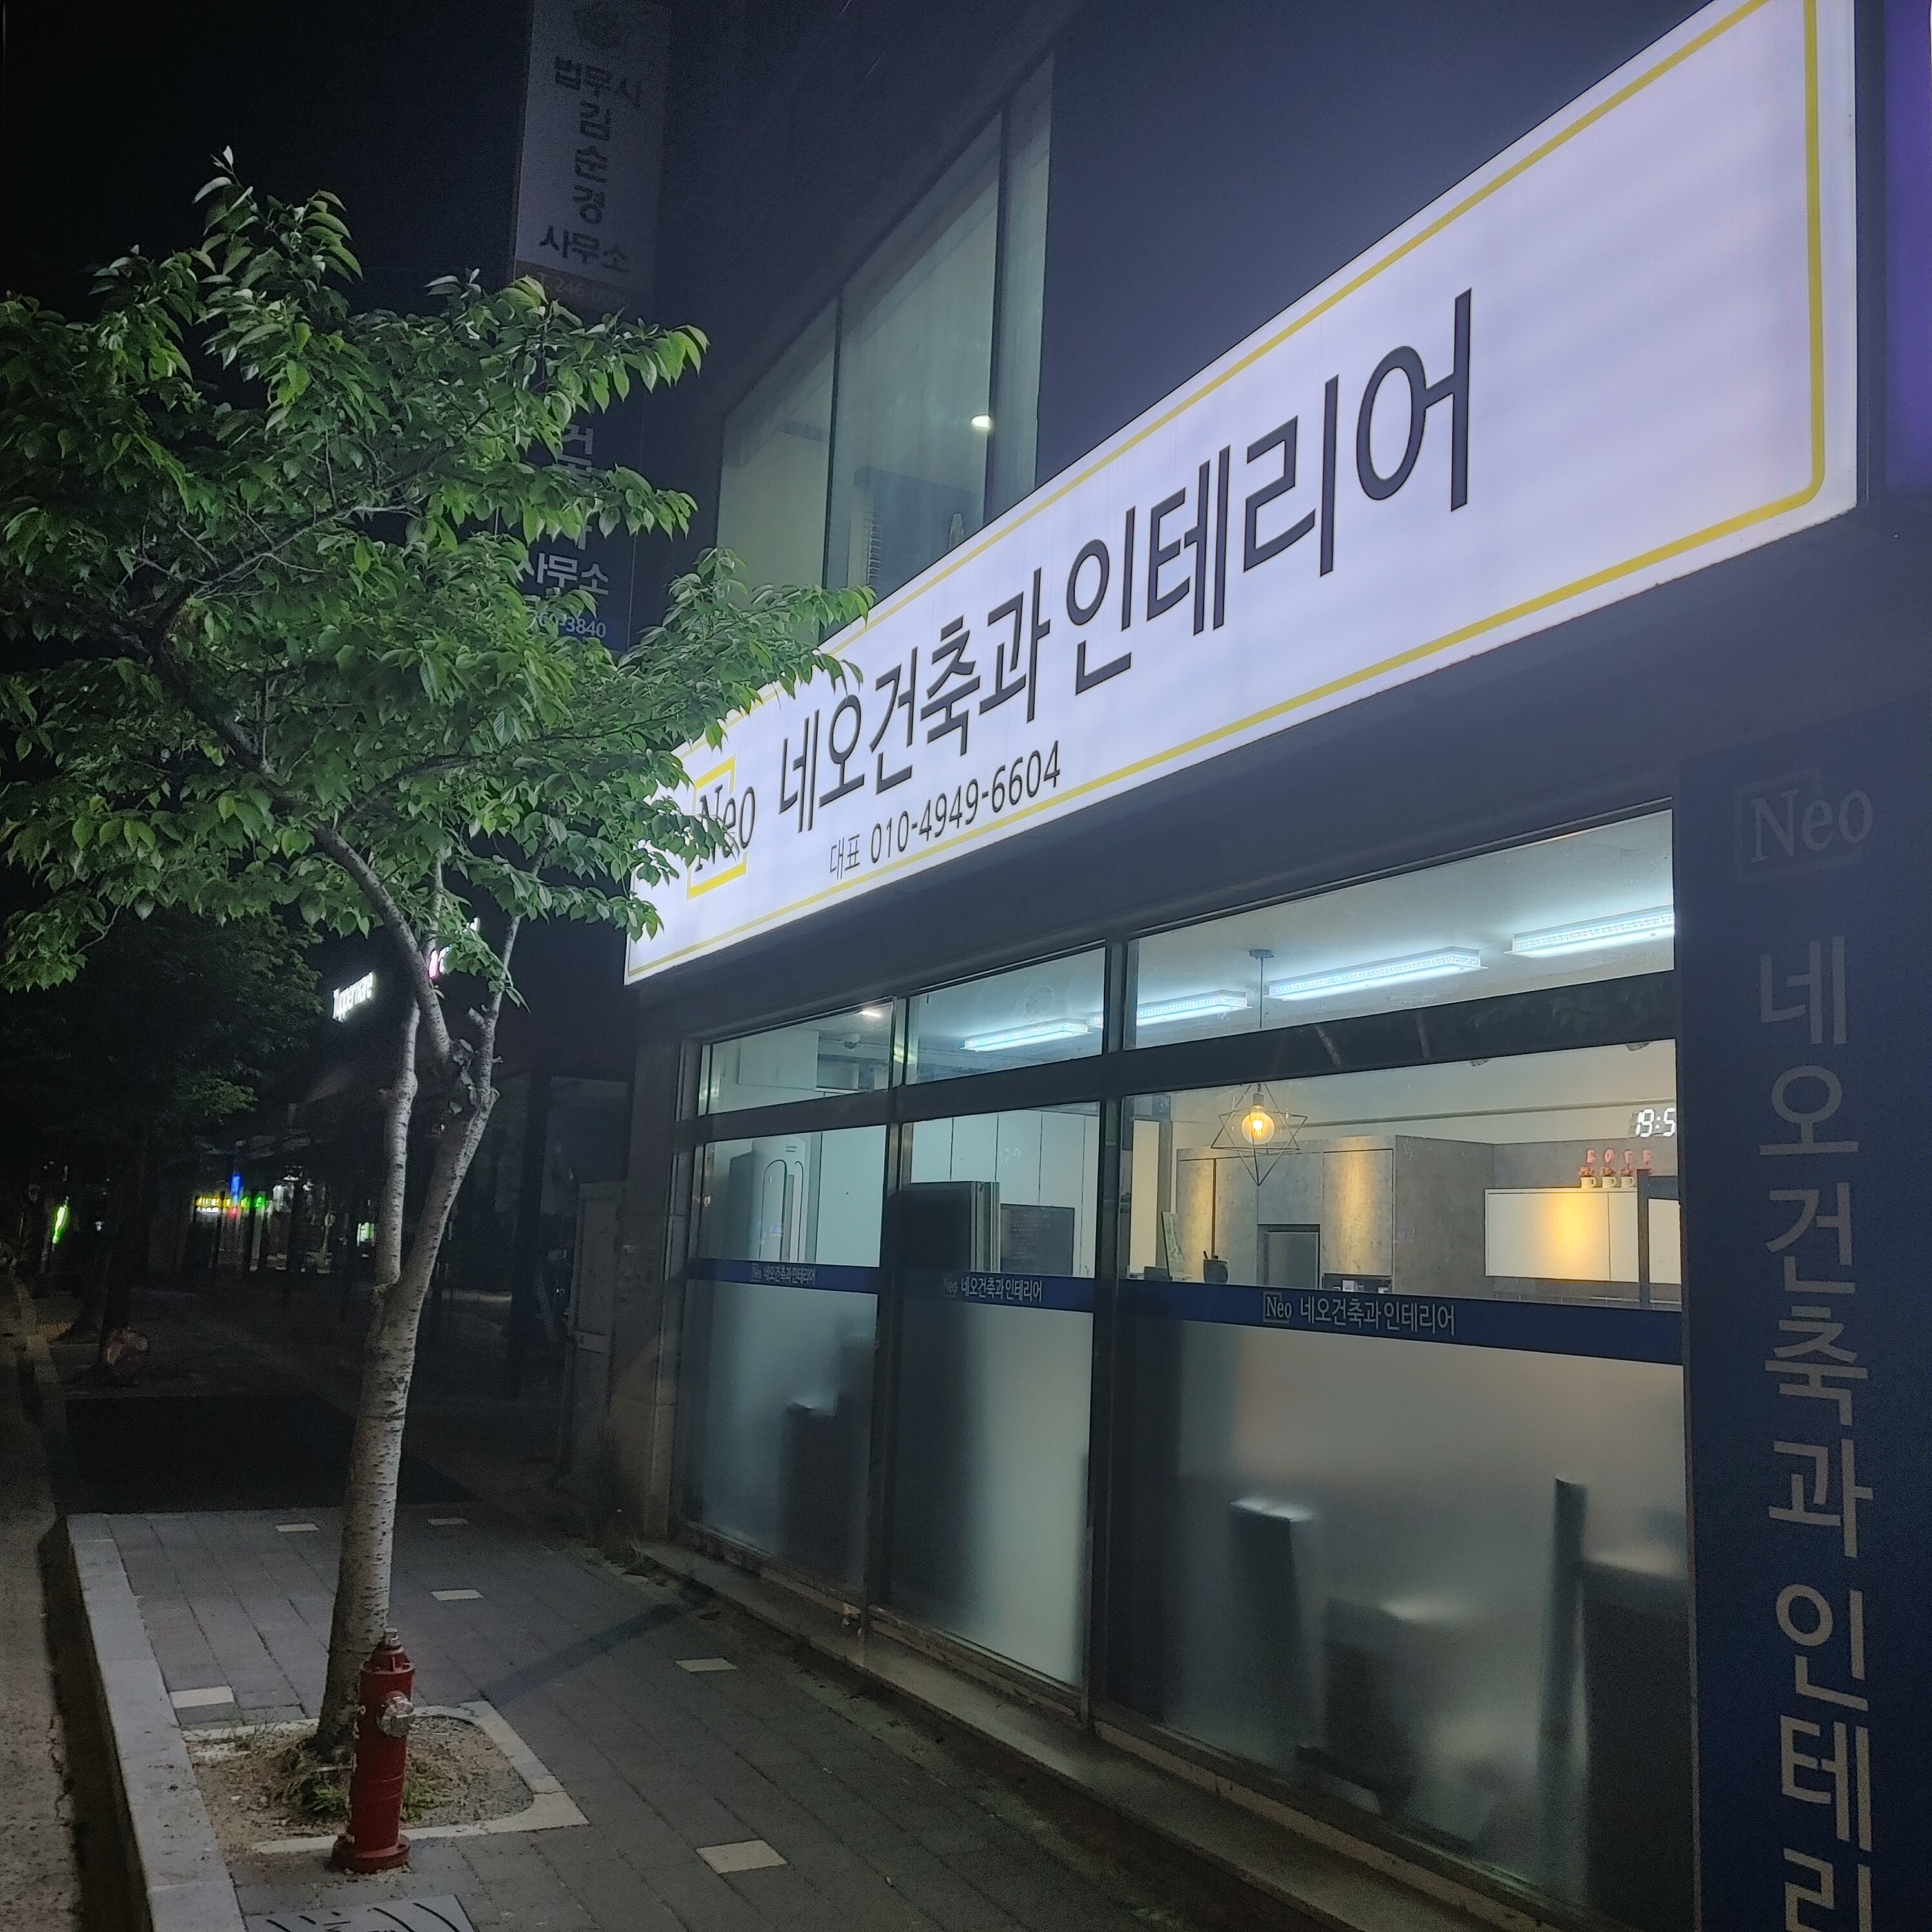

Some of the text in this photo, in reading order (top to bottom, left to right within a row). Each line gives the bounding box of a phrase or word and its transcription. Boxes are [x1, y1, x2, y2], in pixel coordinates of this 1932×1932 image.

[554, 57, 640, 108] 법무사
[540, 225, 629, 273] 사무소
[516, 550, 609, 596] 사무소
[695, 784, 755, 873] Neo
[829, 741, 1061, 880] 대표 010-4949-6604
[1750, 789, 1874, 863] Neo
[1265, 1296, 1292, 1318] Neo
